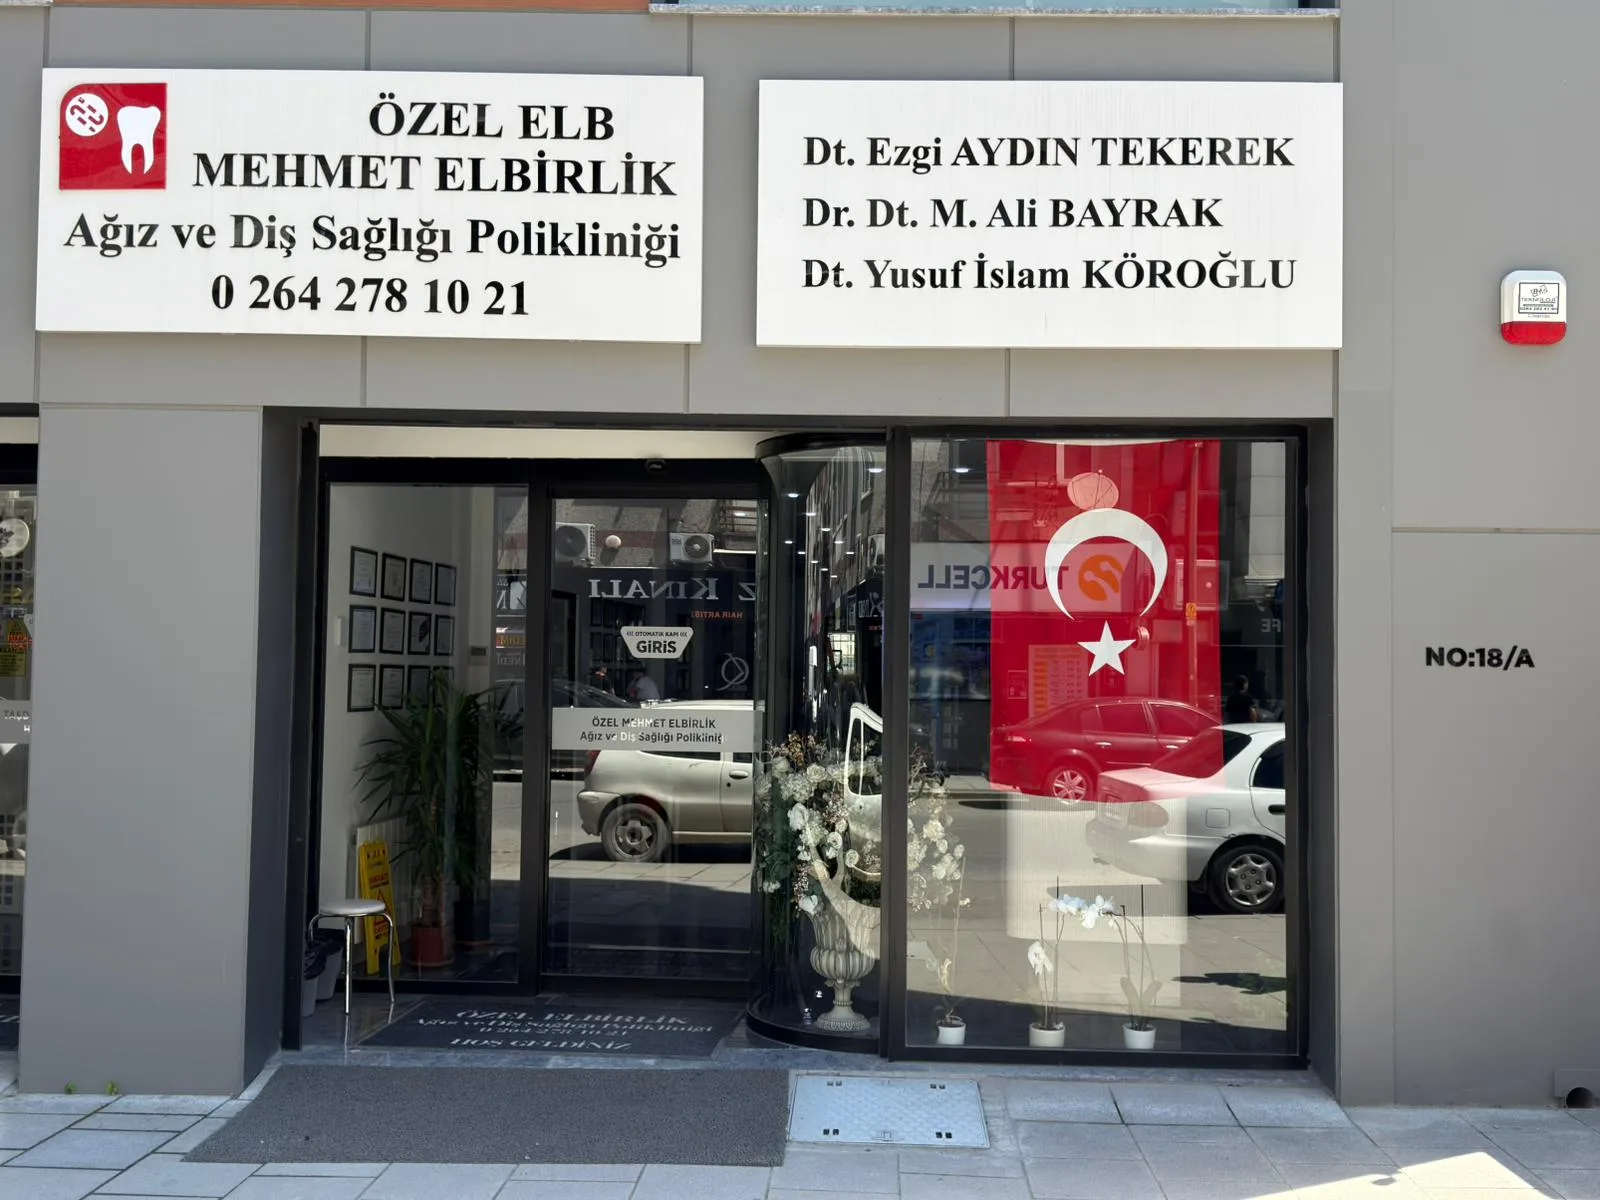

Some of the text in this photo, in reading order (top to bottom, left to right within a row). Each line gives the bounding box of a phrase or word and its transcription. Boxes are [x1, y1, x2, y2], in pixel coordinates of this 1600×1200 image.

[369, 92, 615, 141] ÖZEL ELB
[192, 149, 677, 196] MEHMET ELBİRLİK
[803, 136, 1295, 175] Dt. Ezgi AYDIN TEKEREK
[802, 198, 1223, 228] Dr. Dt. M. Ali BAYRAK
[63, 213, 681, 269] Ağız ve Diş Sağlığı Polikliniği
[802, 251, 1297, 289] Dt. Yusuf İslam KÖROĞLU
[211, 274, 529, 316] 0 264 278 10 21
[1425, 645, 1535, 671] NO:18/A
[580, 730, 602, 742] Ağız
[605, 733, 617, 741] ve
[620, 731, 636, 743] Diş
[638, 731, 674, 744] Sağlığı
[592, 715, 716, 729] ÖZEL MEHMET ELBİRLİK
